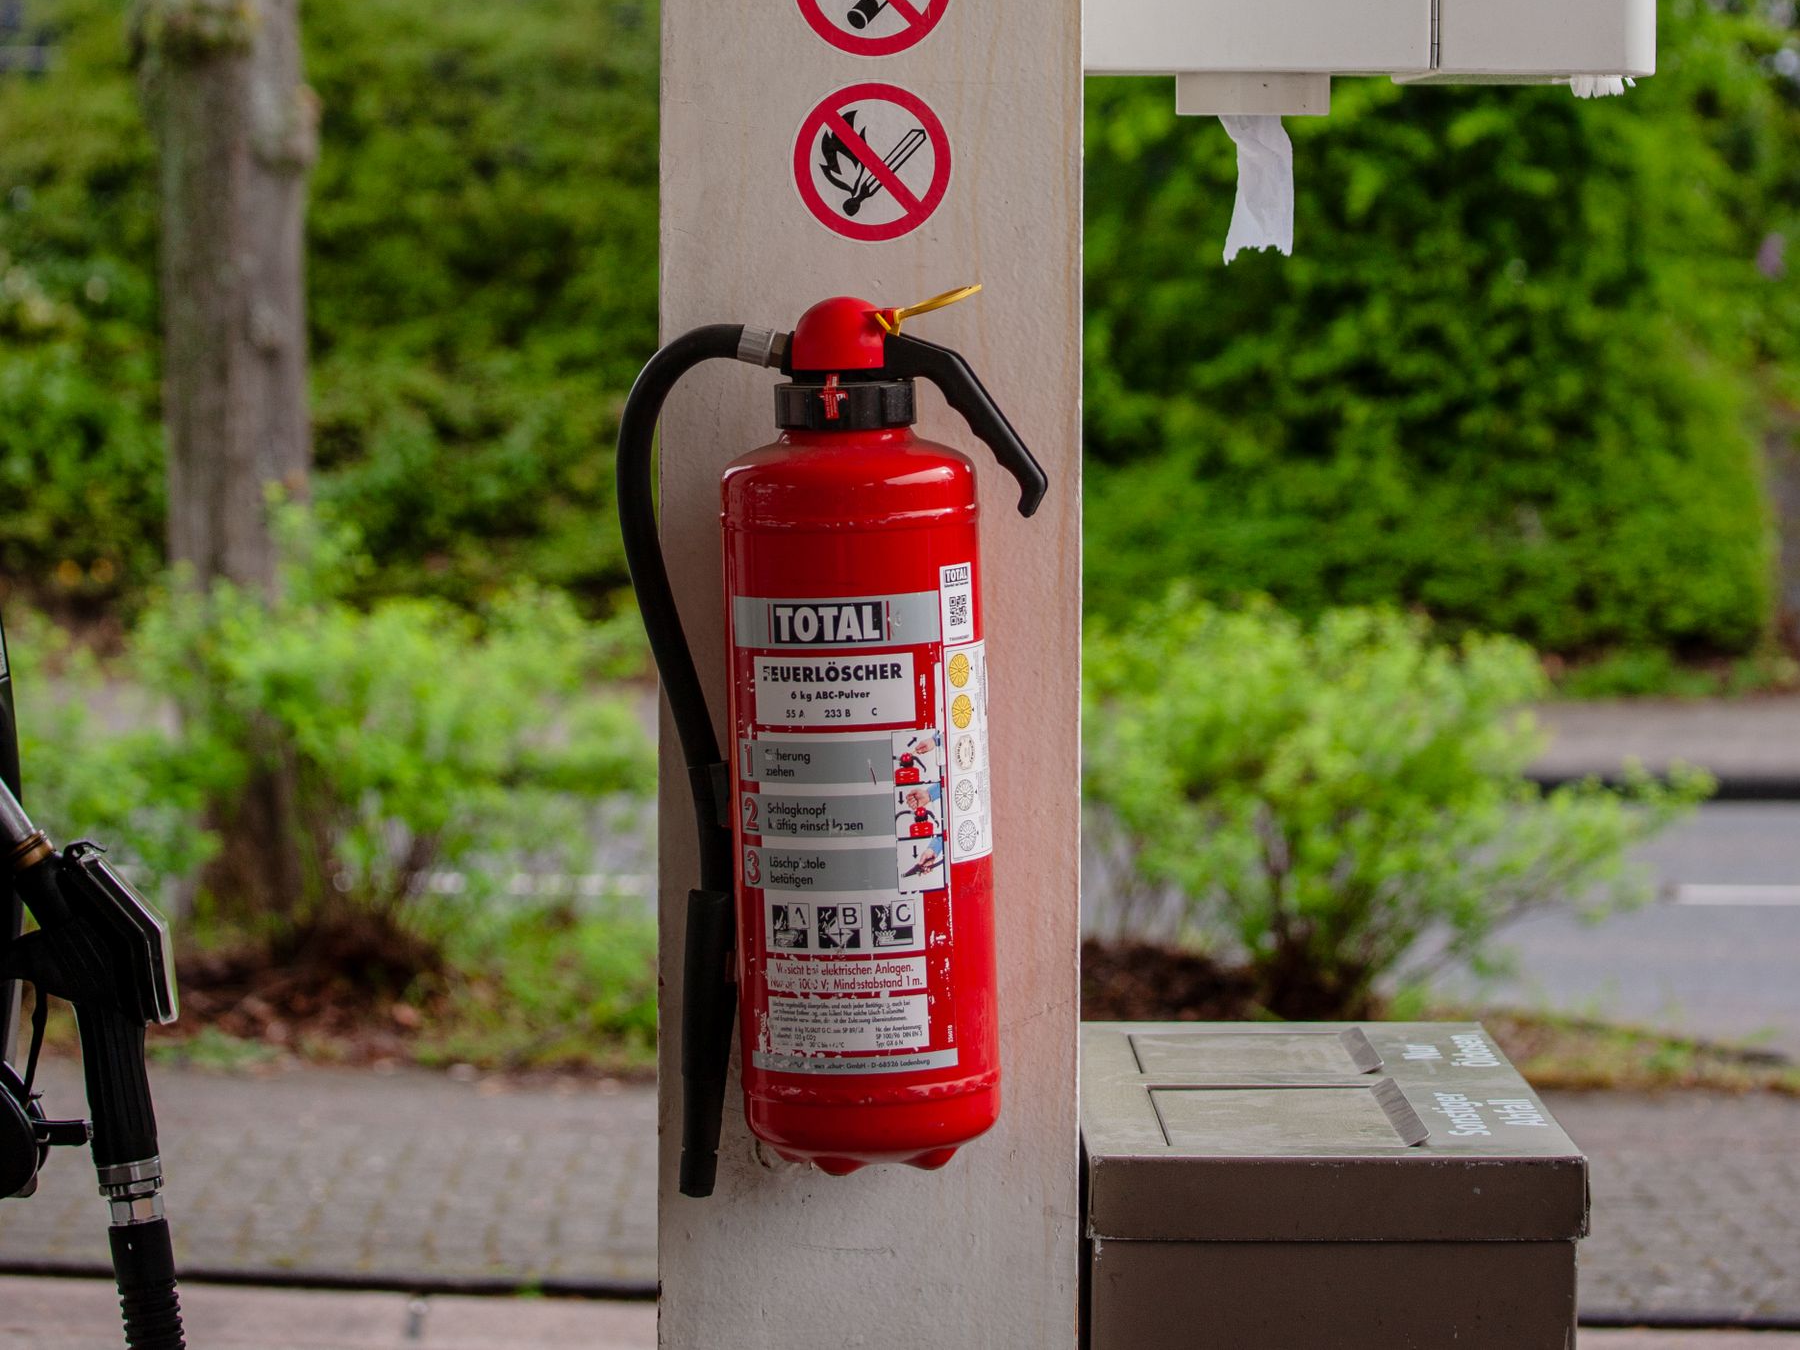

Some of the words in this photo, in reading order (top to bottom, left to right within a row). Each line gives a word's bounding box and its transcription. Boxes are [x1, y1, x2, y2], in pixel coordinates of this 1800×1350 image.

[945, 567, 968, 583] TOTAL
[774, 604, 882, 643] TOTAL
[791, 691, 797, 700] 6
[800, 690, 812, 702] kg
[815, 689, 871, 700] ABC-Pulver
[786, 709, 796, 719] 55
[824, 708, 842, 718] 233
[845, 708, 851, 718] B
[871, 707, 878, 716] C
[744, 796, 760, 832] 2
[767, 802, 826, 818] Schlagknopf
[767, 817, 797, 834] käftig
[747, 850, 761, 885] 3
[769, 856, 826, 871] Löschpstole
[770, 871, 814, 888] betätigen
[842, 907, 857, 925] B
[895, 903, 911, 922] C
[776, 962, 804, 975] Vsicht
[875, 962, 914, 976] Anlagen.
[906, 975, 910, 986] 1
[912, 978, 923, 986] m.
[1402, 1044, 1443, 1061] Nur
[1432, 1092, 1493, 1137] Sonstiger
[1486, 1098, 1549, 1128] Abfall
